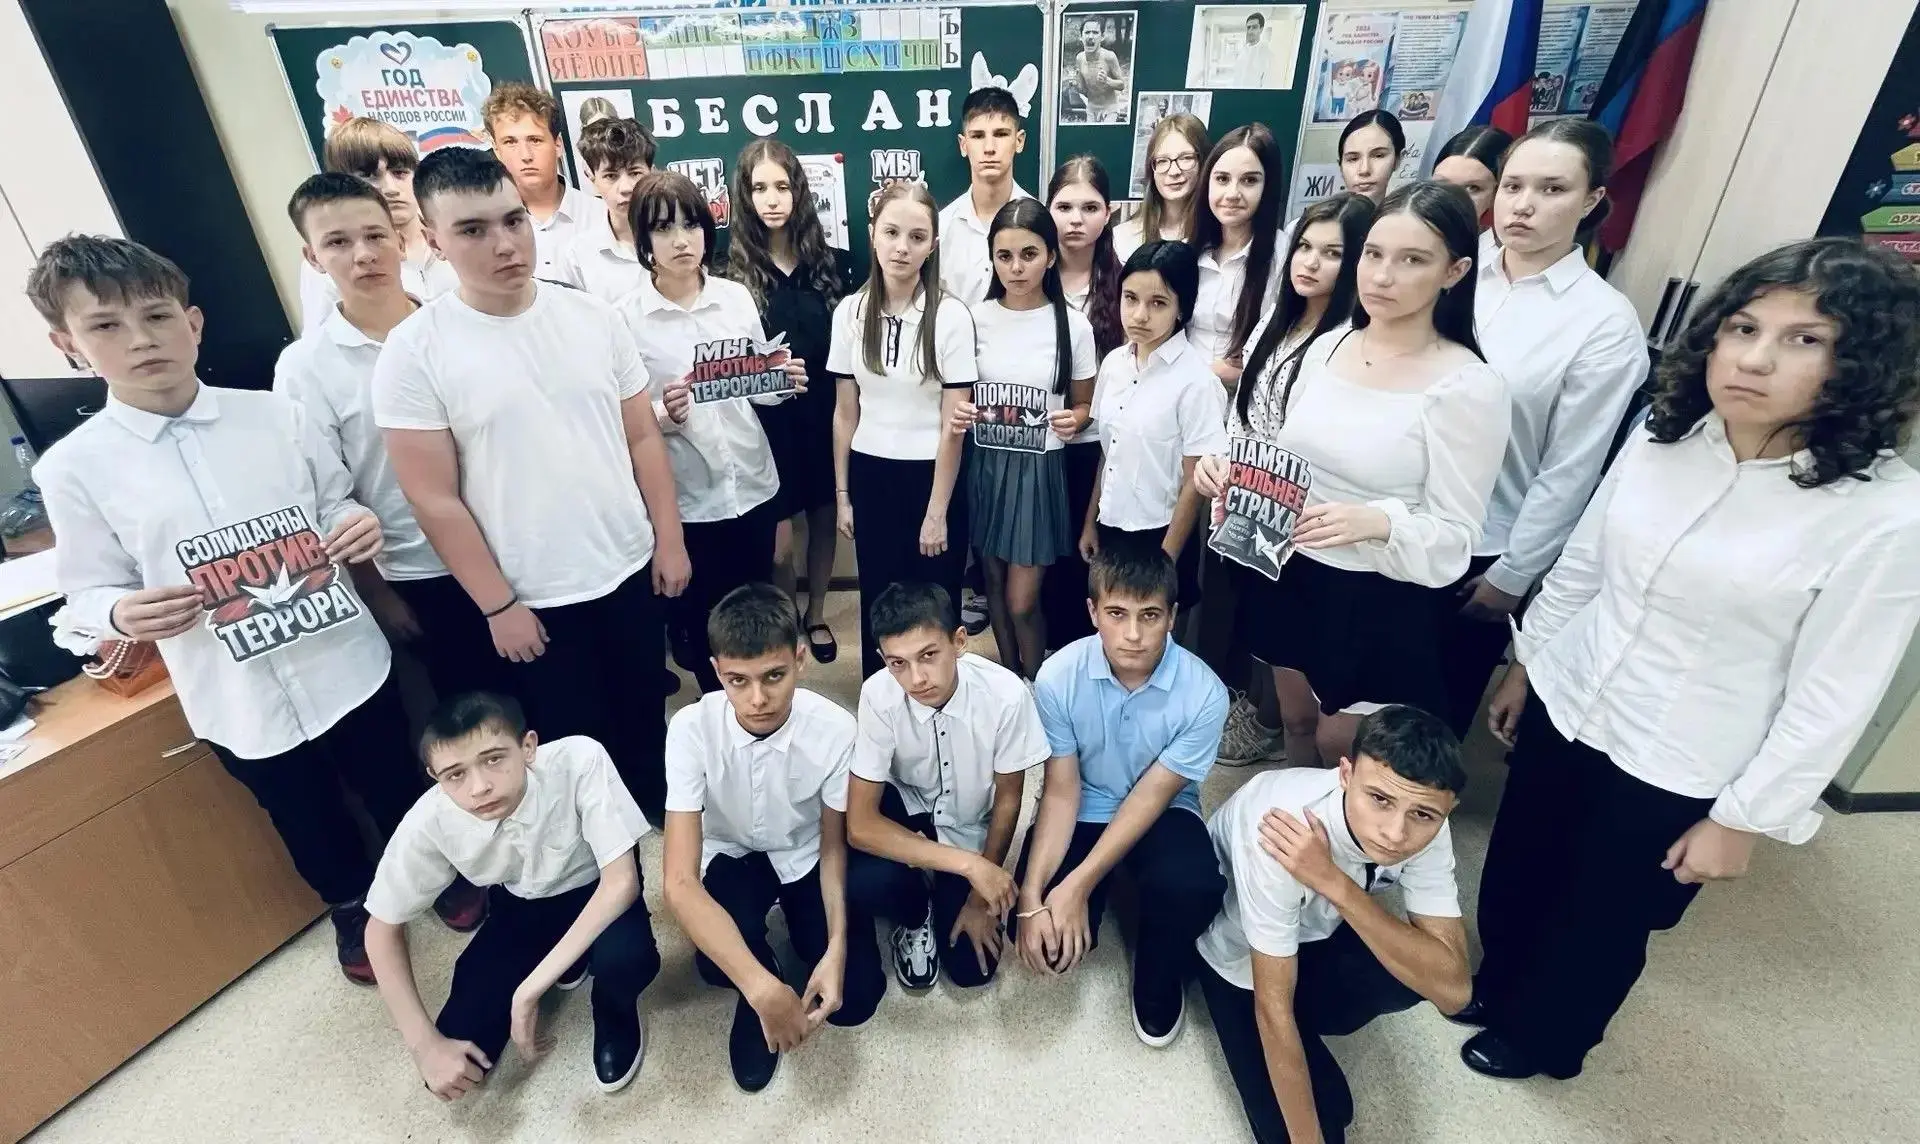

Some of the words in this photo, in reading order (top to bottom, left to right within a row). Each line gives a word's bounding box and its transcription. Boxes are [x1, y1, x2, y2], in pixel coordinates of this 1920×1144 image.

[381, 69, 425, 88] ГОД
[362, 89, 464, 110] ЕДИНСТВА
[368, 110, 421, 124] НАРОДОВ
[424, 110, 467, 122] РОССИИ
[647, 89, 952, 138] БЕСЛАН
[873, 152, 918, 178] МЫ
[1304, 176, 1336, 197] ЖИ
[695, 337, 751, 363] МЫ
[696, 356, 767, 381] ПРОТИВ
[977, 384, 1046, 411] ПОМНИМ
[1003, 406, 1018, 424] И
[977, 423, 1046, 450] СКОРБИМ
[1231, 437, 1311, 489] ПАМЯТЬ
[1229, 463, 1308, 512] СИЛЬНЕЕ
[1225, 486, 1297, 536] СТРАХА
[177, 506, 308, 566] СОЛИДАРНЫ
[190, 531, 322, 605] ПРОТИВ
[217, 585, 358, 658] ТЕРРОРА
